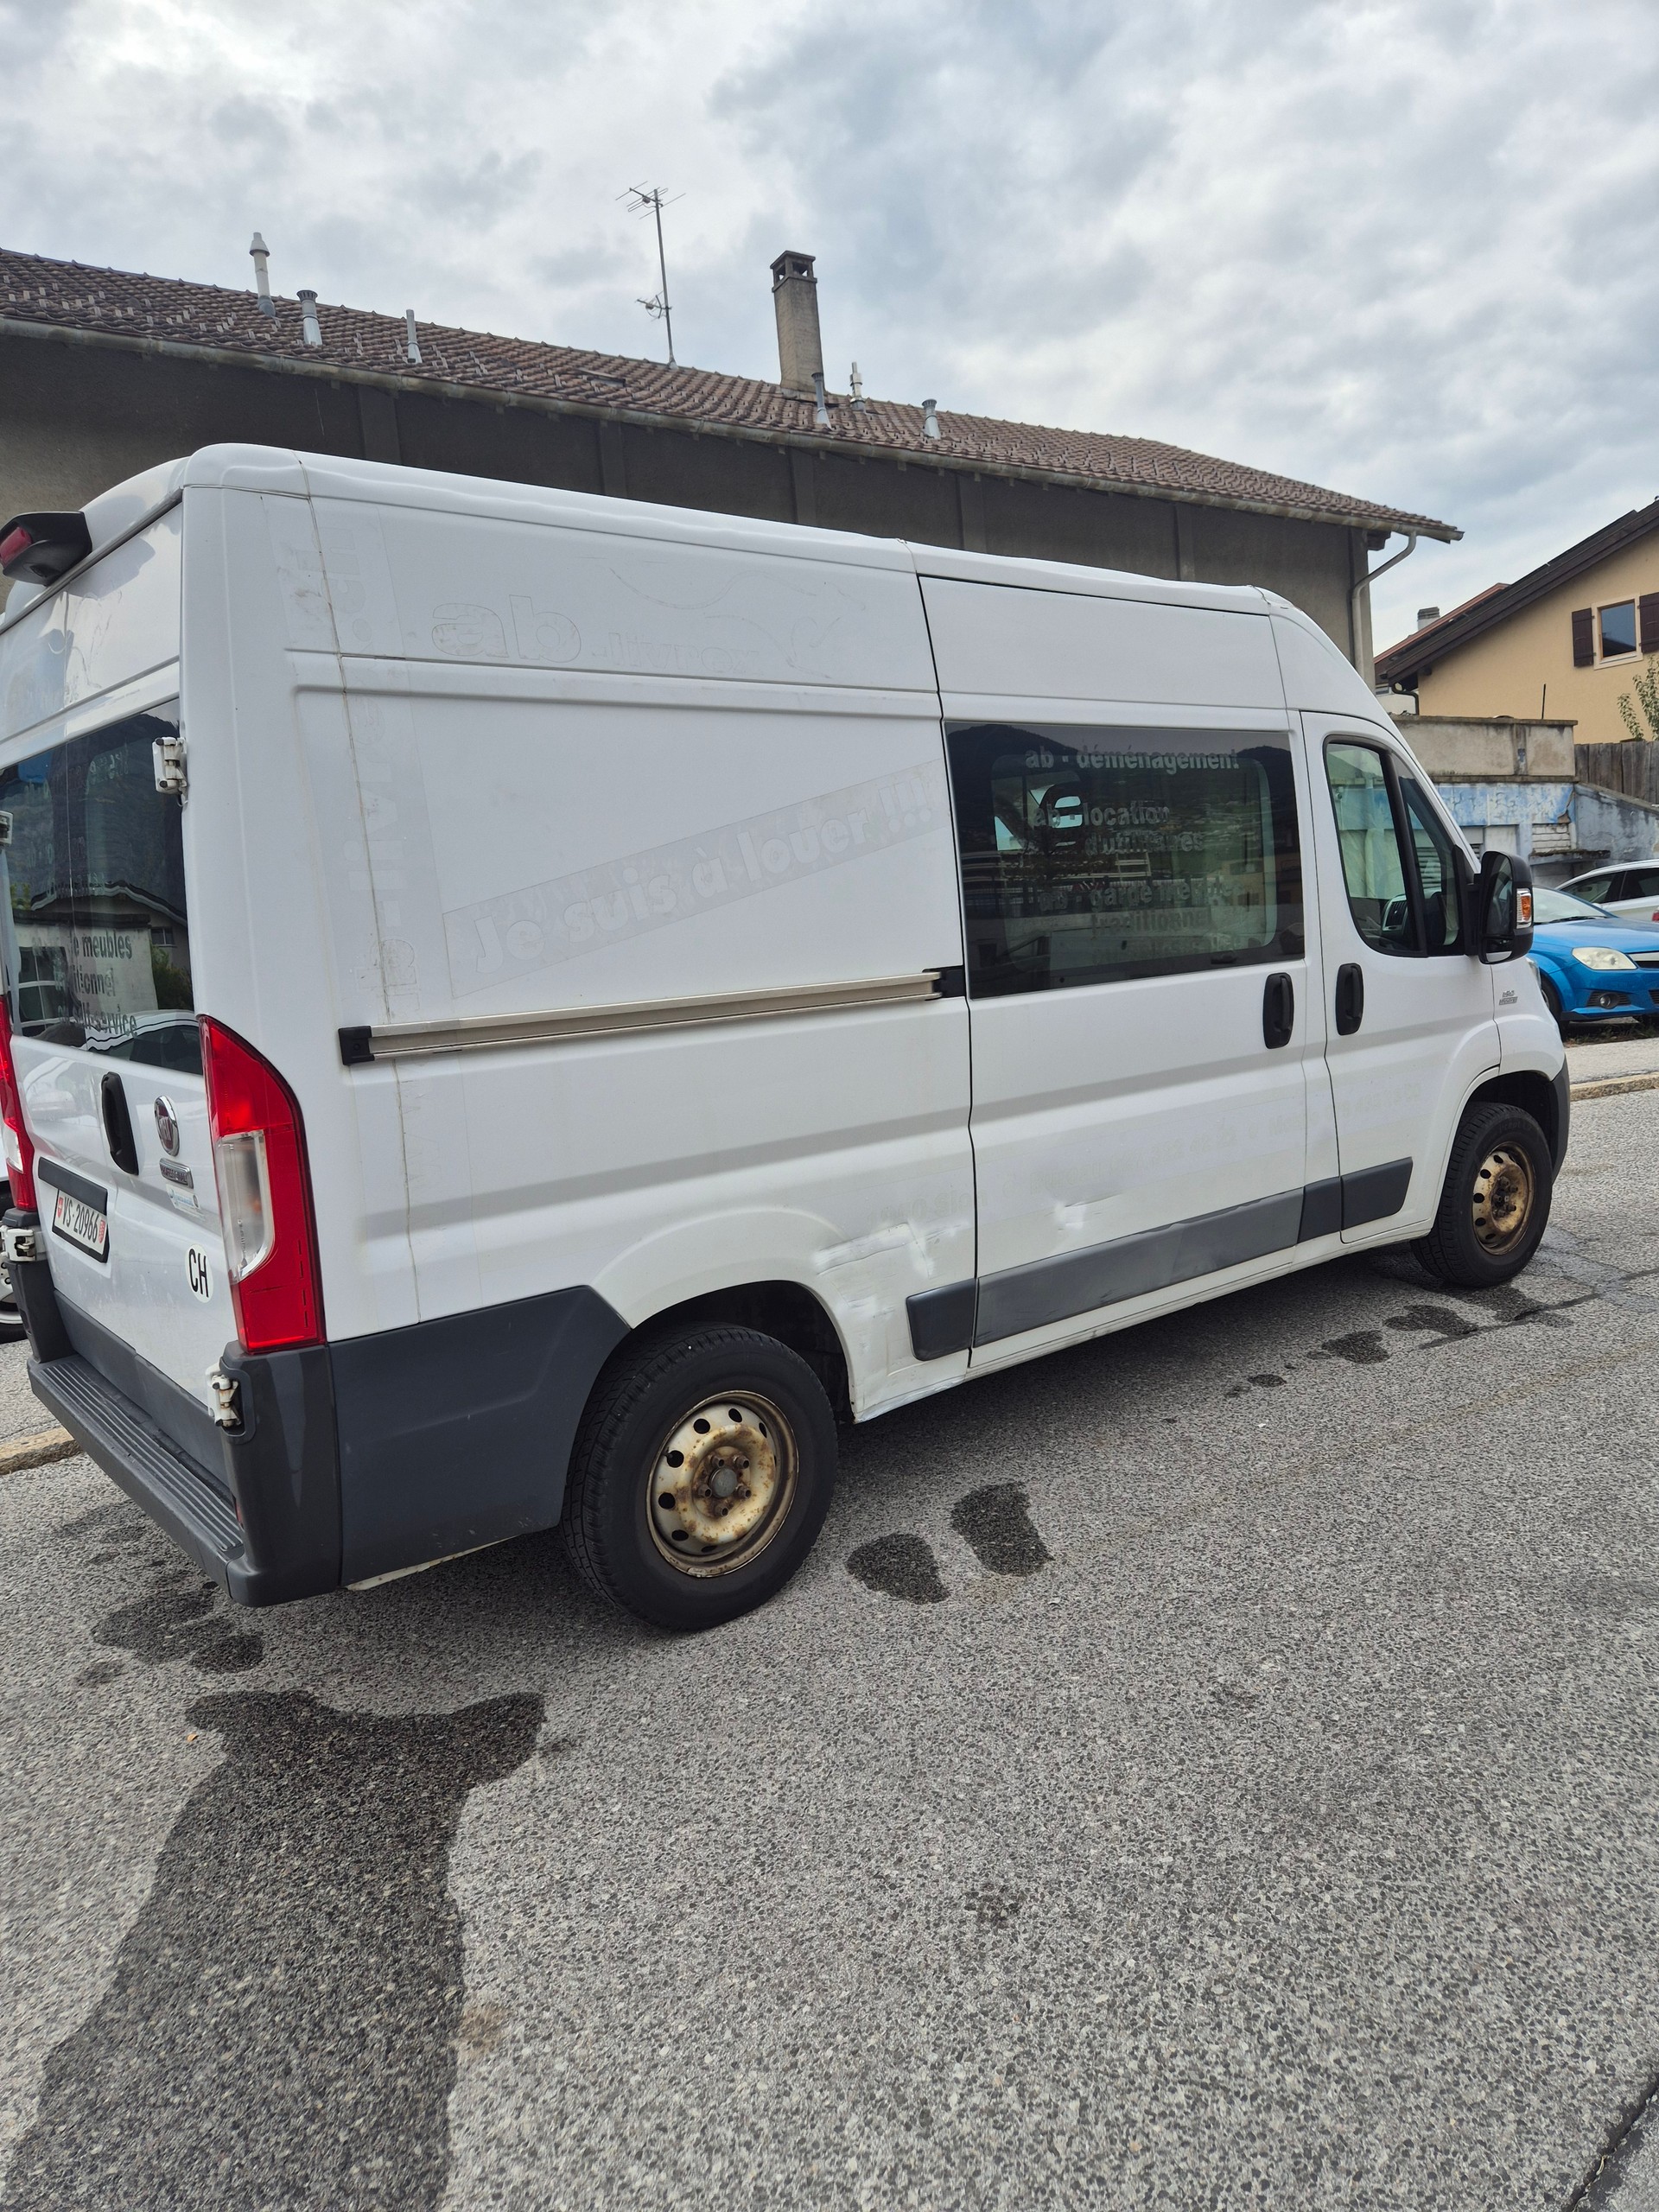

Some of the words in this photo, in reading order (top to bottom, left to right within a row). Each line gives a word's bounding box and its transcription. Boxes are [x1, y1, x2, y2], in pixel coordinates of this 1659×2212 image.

[1026, 745, 1054, 769] ab
[1077, 740, 1240, 774] déménagement
[1083, 800, 1171, 827] location
[474, 915, 546, 973] Je
[563, 867, 677, 943] suis
[692, 847, 728, 898] à
[737, 807, 870, 881] louer
[82, 930, 132, 960] meubles
[188, 1248, 209, 1298] CH
